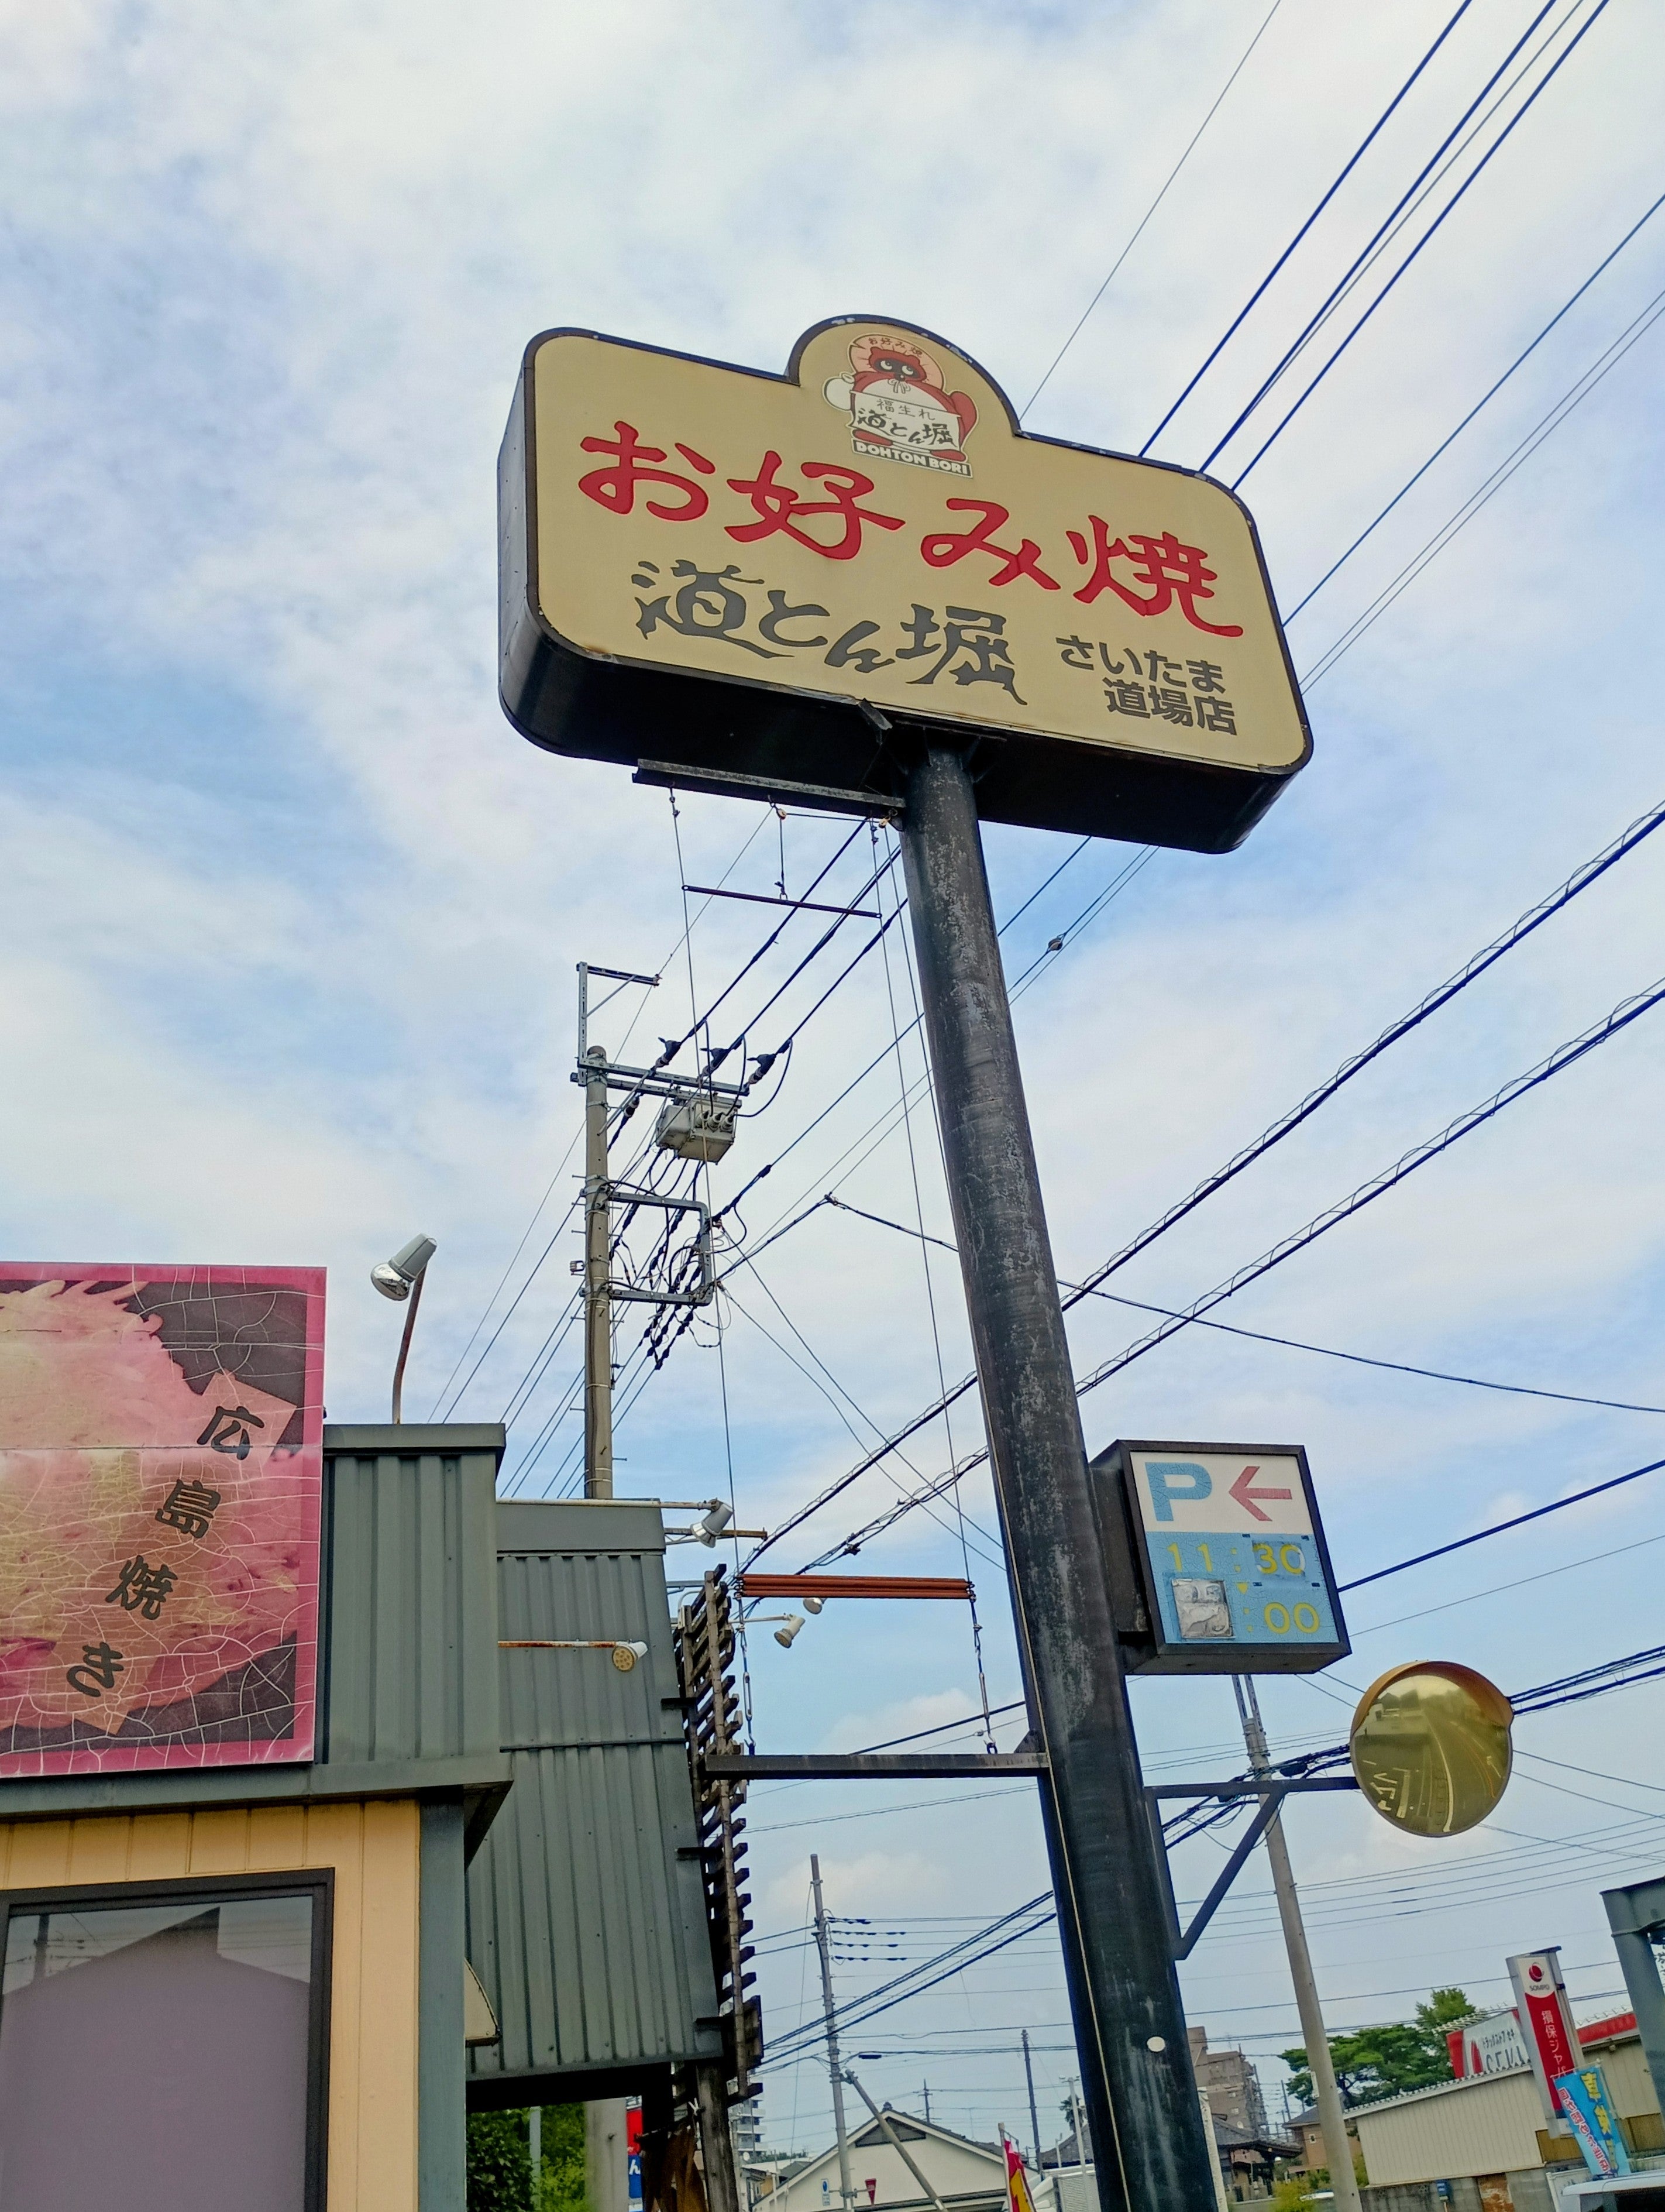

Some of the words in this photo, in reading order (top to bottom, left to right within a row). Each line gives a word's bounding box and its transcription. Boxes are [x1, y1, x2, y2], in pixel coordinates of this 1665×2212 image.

[856, 408, 958, 447] 道とん堀
[876, 399, 935, 421] 福生れ
[856, 441, 926, 466] DOHTON
[929, 457, 968, 475] BORI
[579, 420, 1244, 637] お好み焼
[631, 559, 1027, 705] 道とん堀
[1055, 635, 1226, 695] さいたま
[1102, 677, 1237, 736] 道場店
[1144, 1462, 1213, 1521] P
[66, 1406, 264, 1698] 広島焼き
[1541, 2010, 1567, 2078] 損保ジャパ
